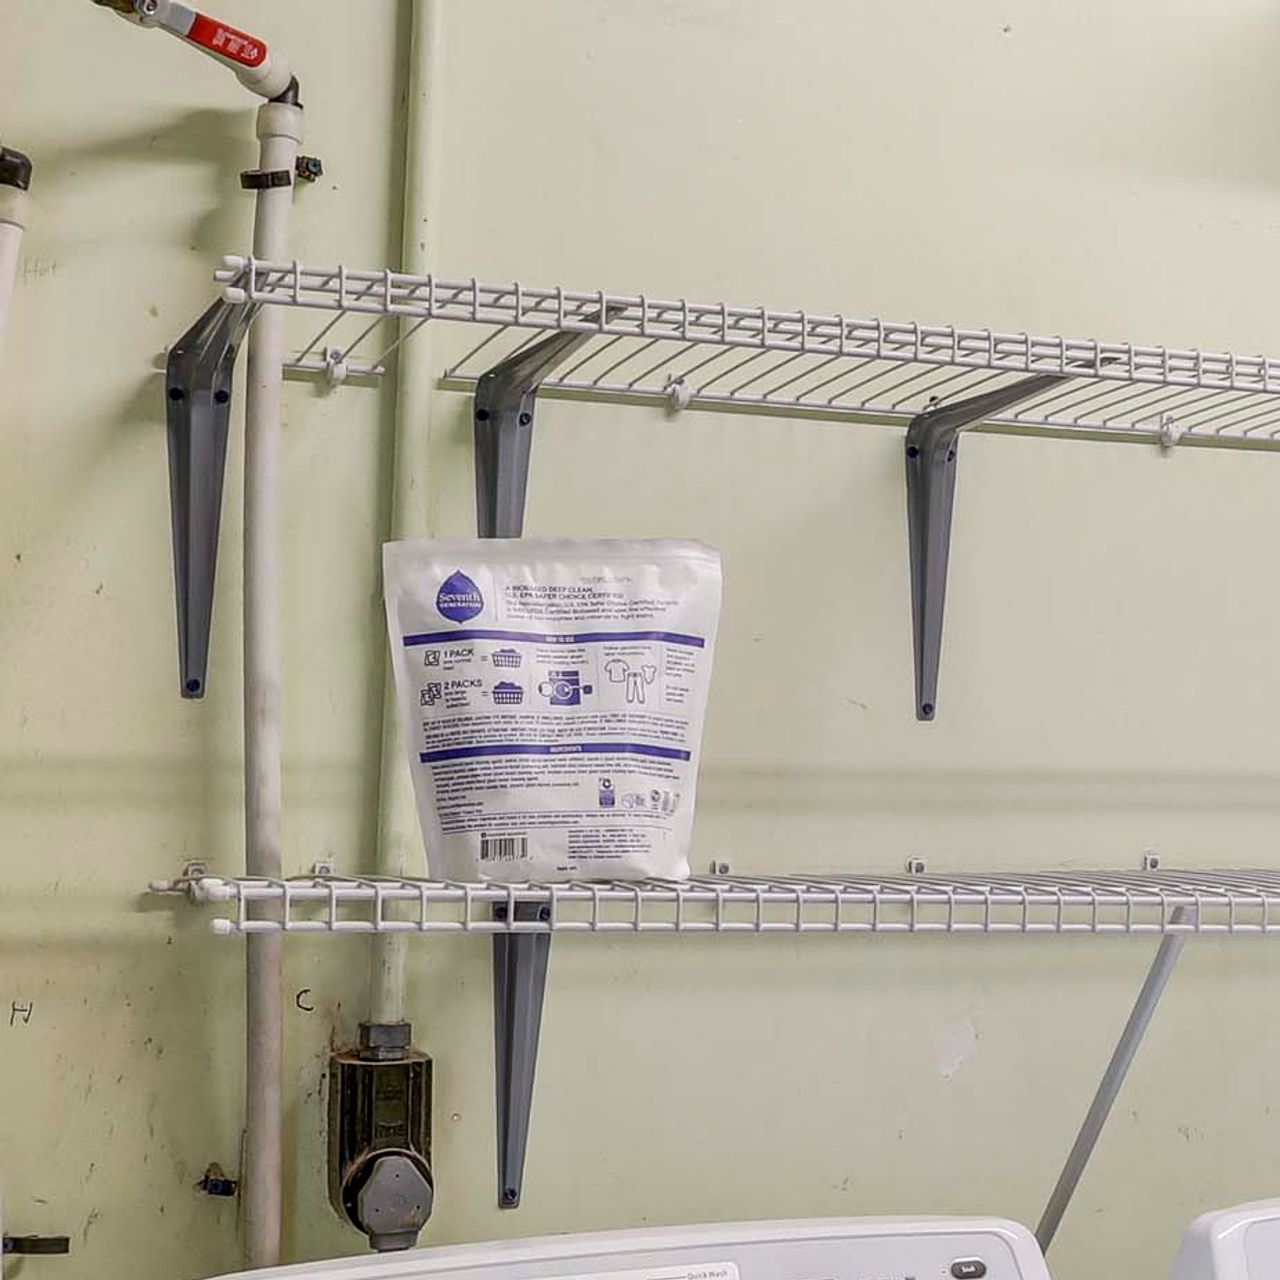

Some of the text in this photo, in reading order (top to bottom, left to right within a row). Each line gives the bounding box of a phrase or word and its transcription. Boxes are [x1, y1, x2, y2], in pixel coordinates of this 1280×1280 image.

[440, 592, 480, 602] Seventh
[450, 649, 474, 658] PACK
[451, 679, 482, 688] PACKS
[296, 988, 314, 1012] C
[10, 1000, 33, 1026] H
